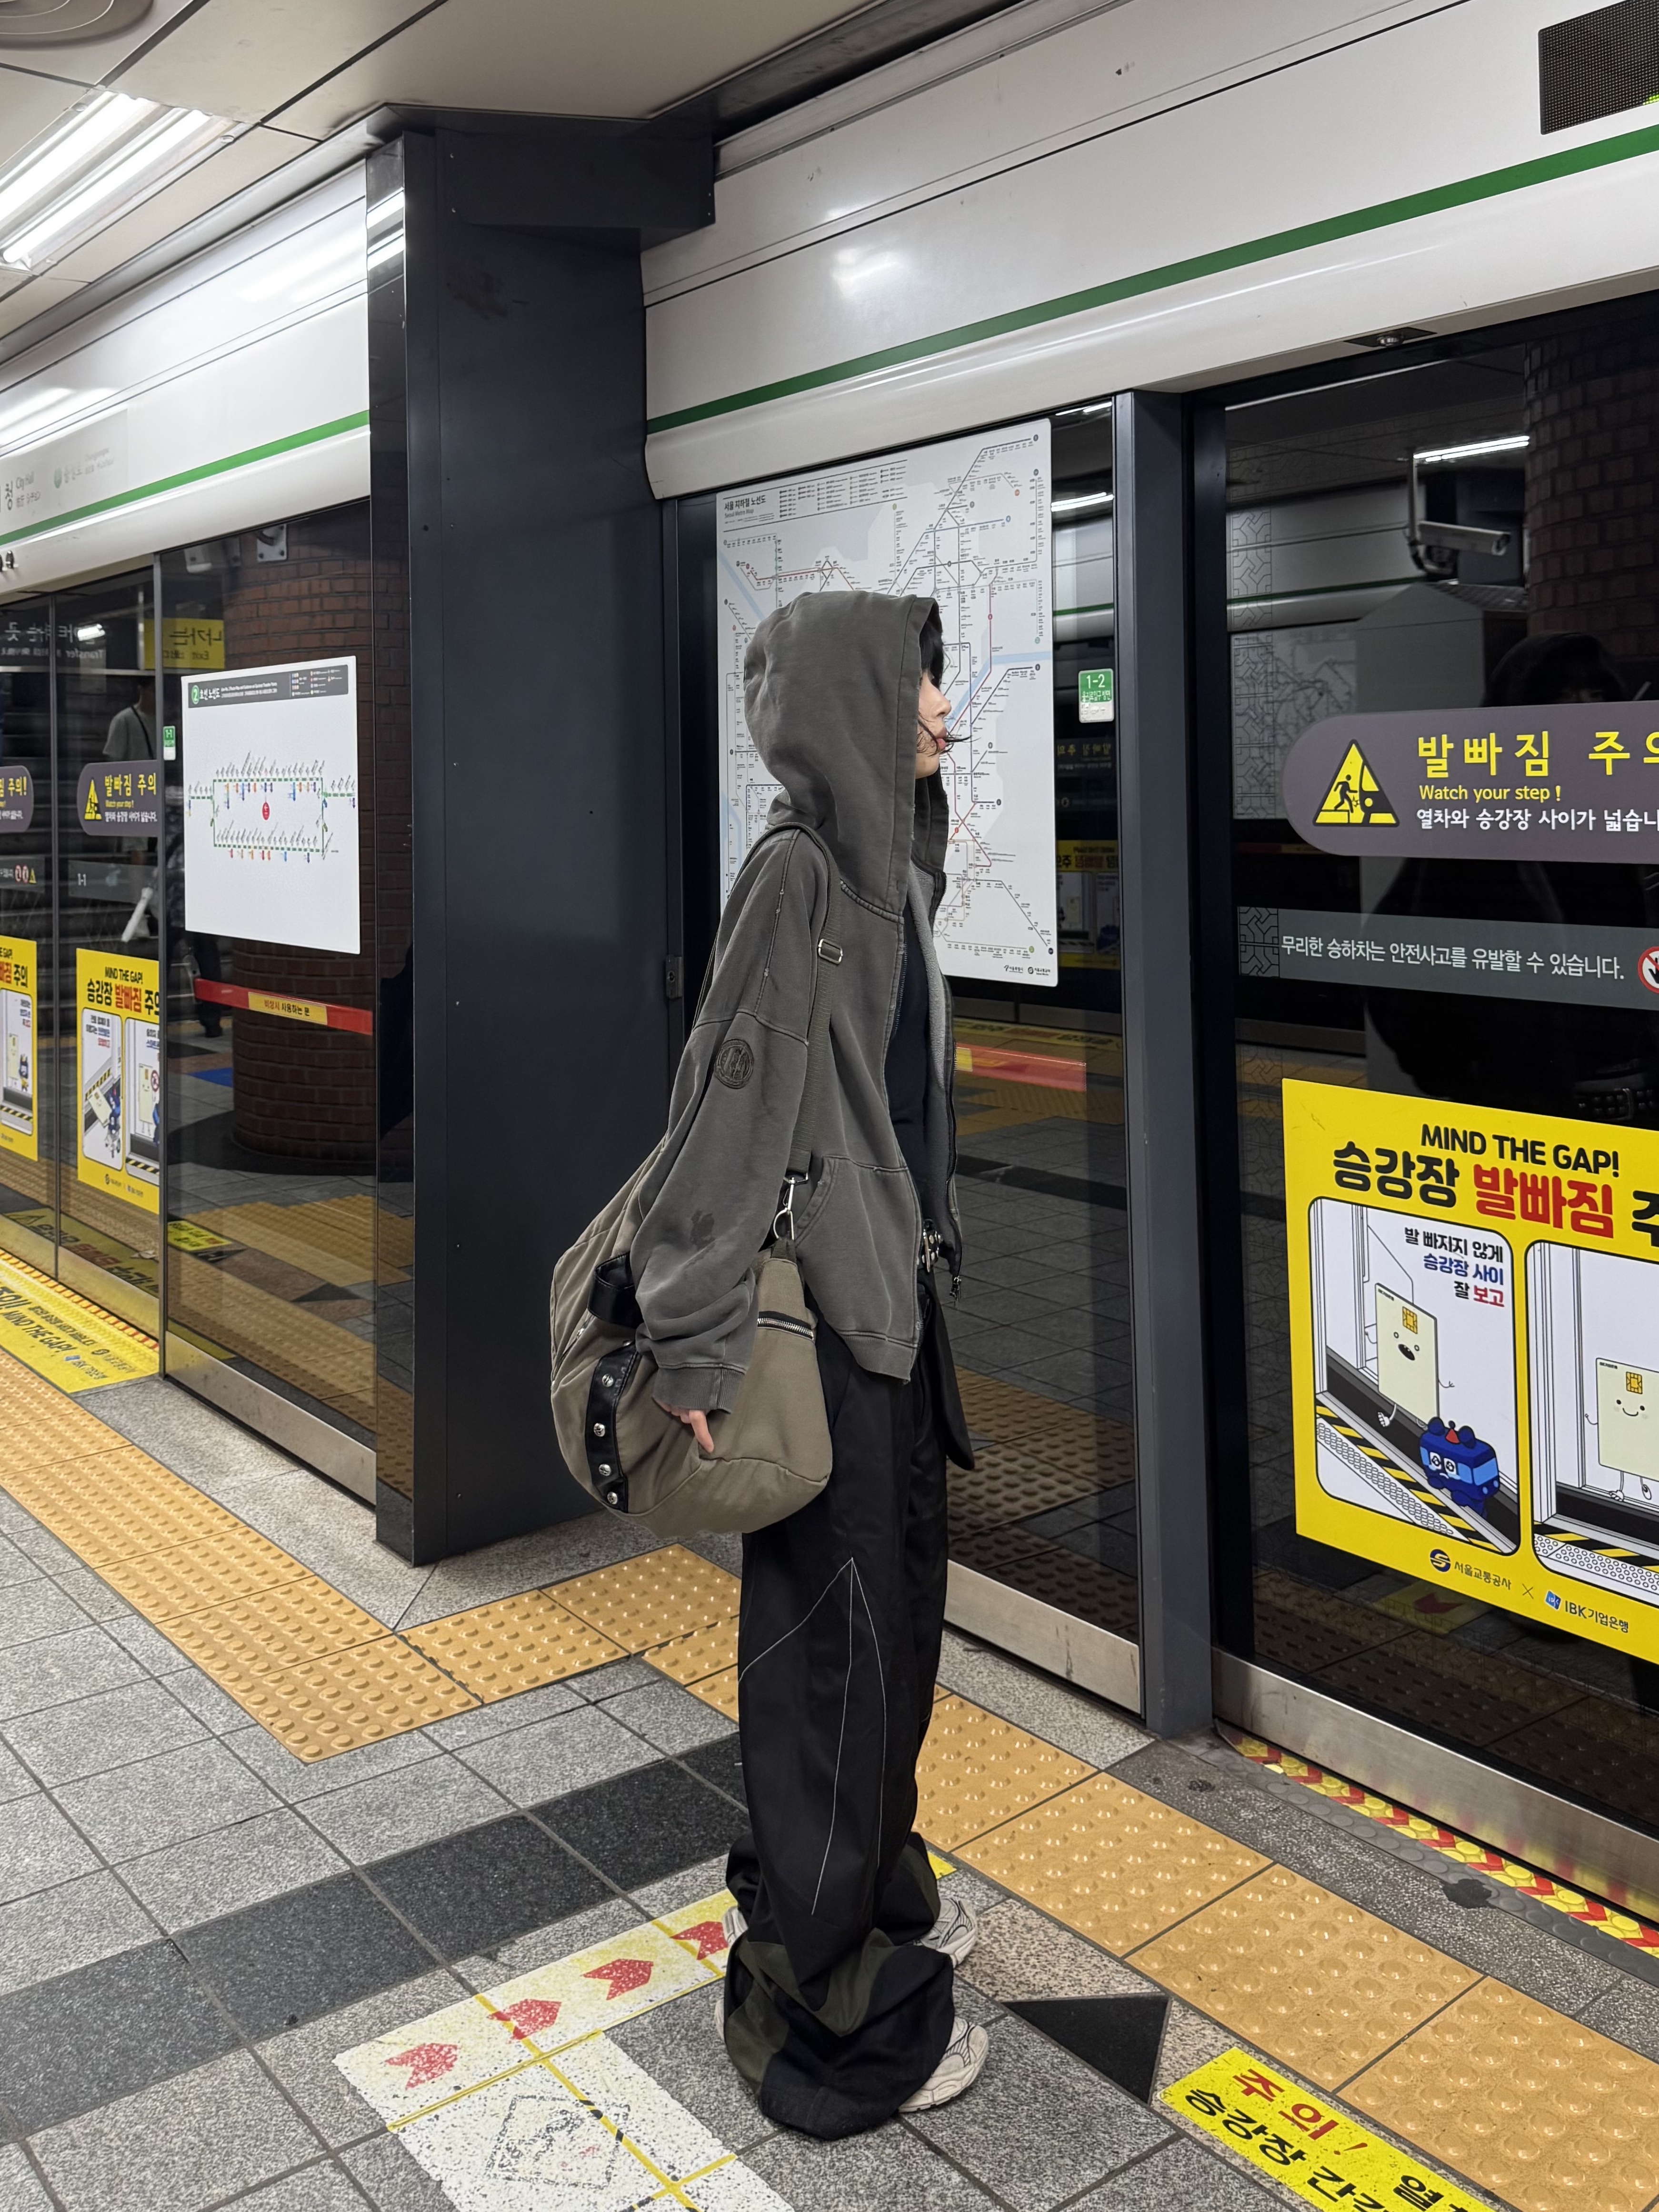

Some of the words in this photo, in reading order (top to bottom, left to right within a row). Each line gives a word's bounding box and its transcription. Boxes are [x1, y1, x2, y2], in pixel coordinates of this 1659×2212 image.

[724, 501, 734, 511] 서울
[735, 498, 750, 509] 지하철
[751, 495, 766, 505] 노선도
[1086, 673, 1106, 689] 1-2
[1417, 731, 1549, 778] 발빠짐
[105, 773, 132, 797] 발빠짐
[137, 772, 156, 796] 주의
[1419, 785, 1468, 801] Watch
[1474, 788, 1512, 803] your
[1515, 787, 1550, 802] step
[1417, 809, 1469, 830] 열차와
[1476, 809, 1532, 831] 승강장
[1539, 809, 1596, 831] 사이가
[105, 966, 118, 980] MIND
[119, 969, 130, 982] THE
[1281, 936, 1322, 957] 무리한
[1327, 938, 1386, 962] 승하차는
[1389, 941, 1468, 968] 안전사고를
[1471, 948, 1521, 972] 유발할
[1526, 951, 1545, 974] 수
[1550, 953, 1625, 980] 있습니다.
[14, 963, 28, 988] 주의
[87, 978, 113, 1006] 승강장
[115, 983, 142, 1013] 발빠짐
[1421, 1123, 1486, 1155] MIND
[1492, 1134, 1545, 1165] THE
[1553, 1144, 1619, 1178] GAP!
[1333, 1141, 1460, 1208] 승강장
[1473, 1163, 1614, 1239] 발빠짐
[1404, 1227, 1419, 1245] 발
[1423, 1231, 1468, 1256] 빠지지
[1472, 1241, 1503, 1263] 않게
[1423, 1253, 1469, 1277] 승강장
[1472, 1263, 1504, 1286] 사이
[1454, 1281, 1470, 1300] 잘
[1473, 1285, 1505, 1308] 보고
[1454, 1561, 1512, 1590] 서울교통공사
[1565, 1600, 1629, 1633] IBK기업은행
[1185, 2088, 1307, 2166] 승강장
